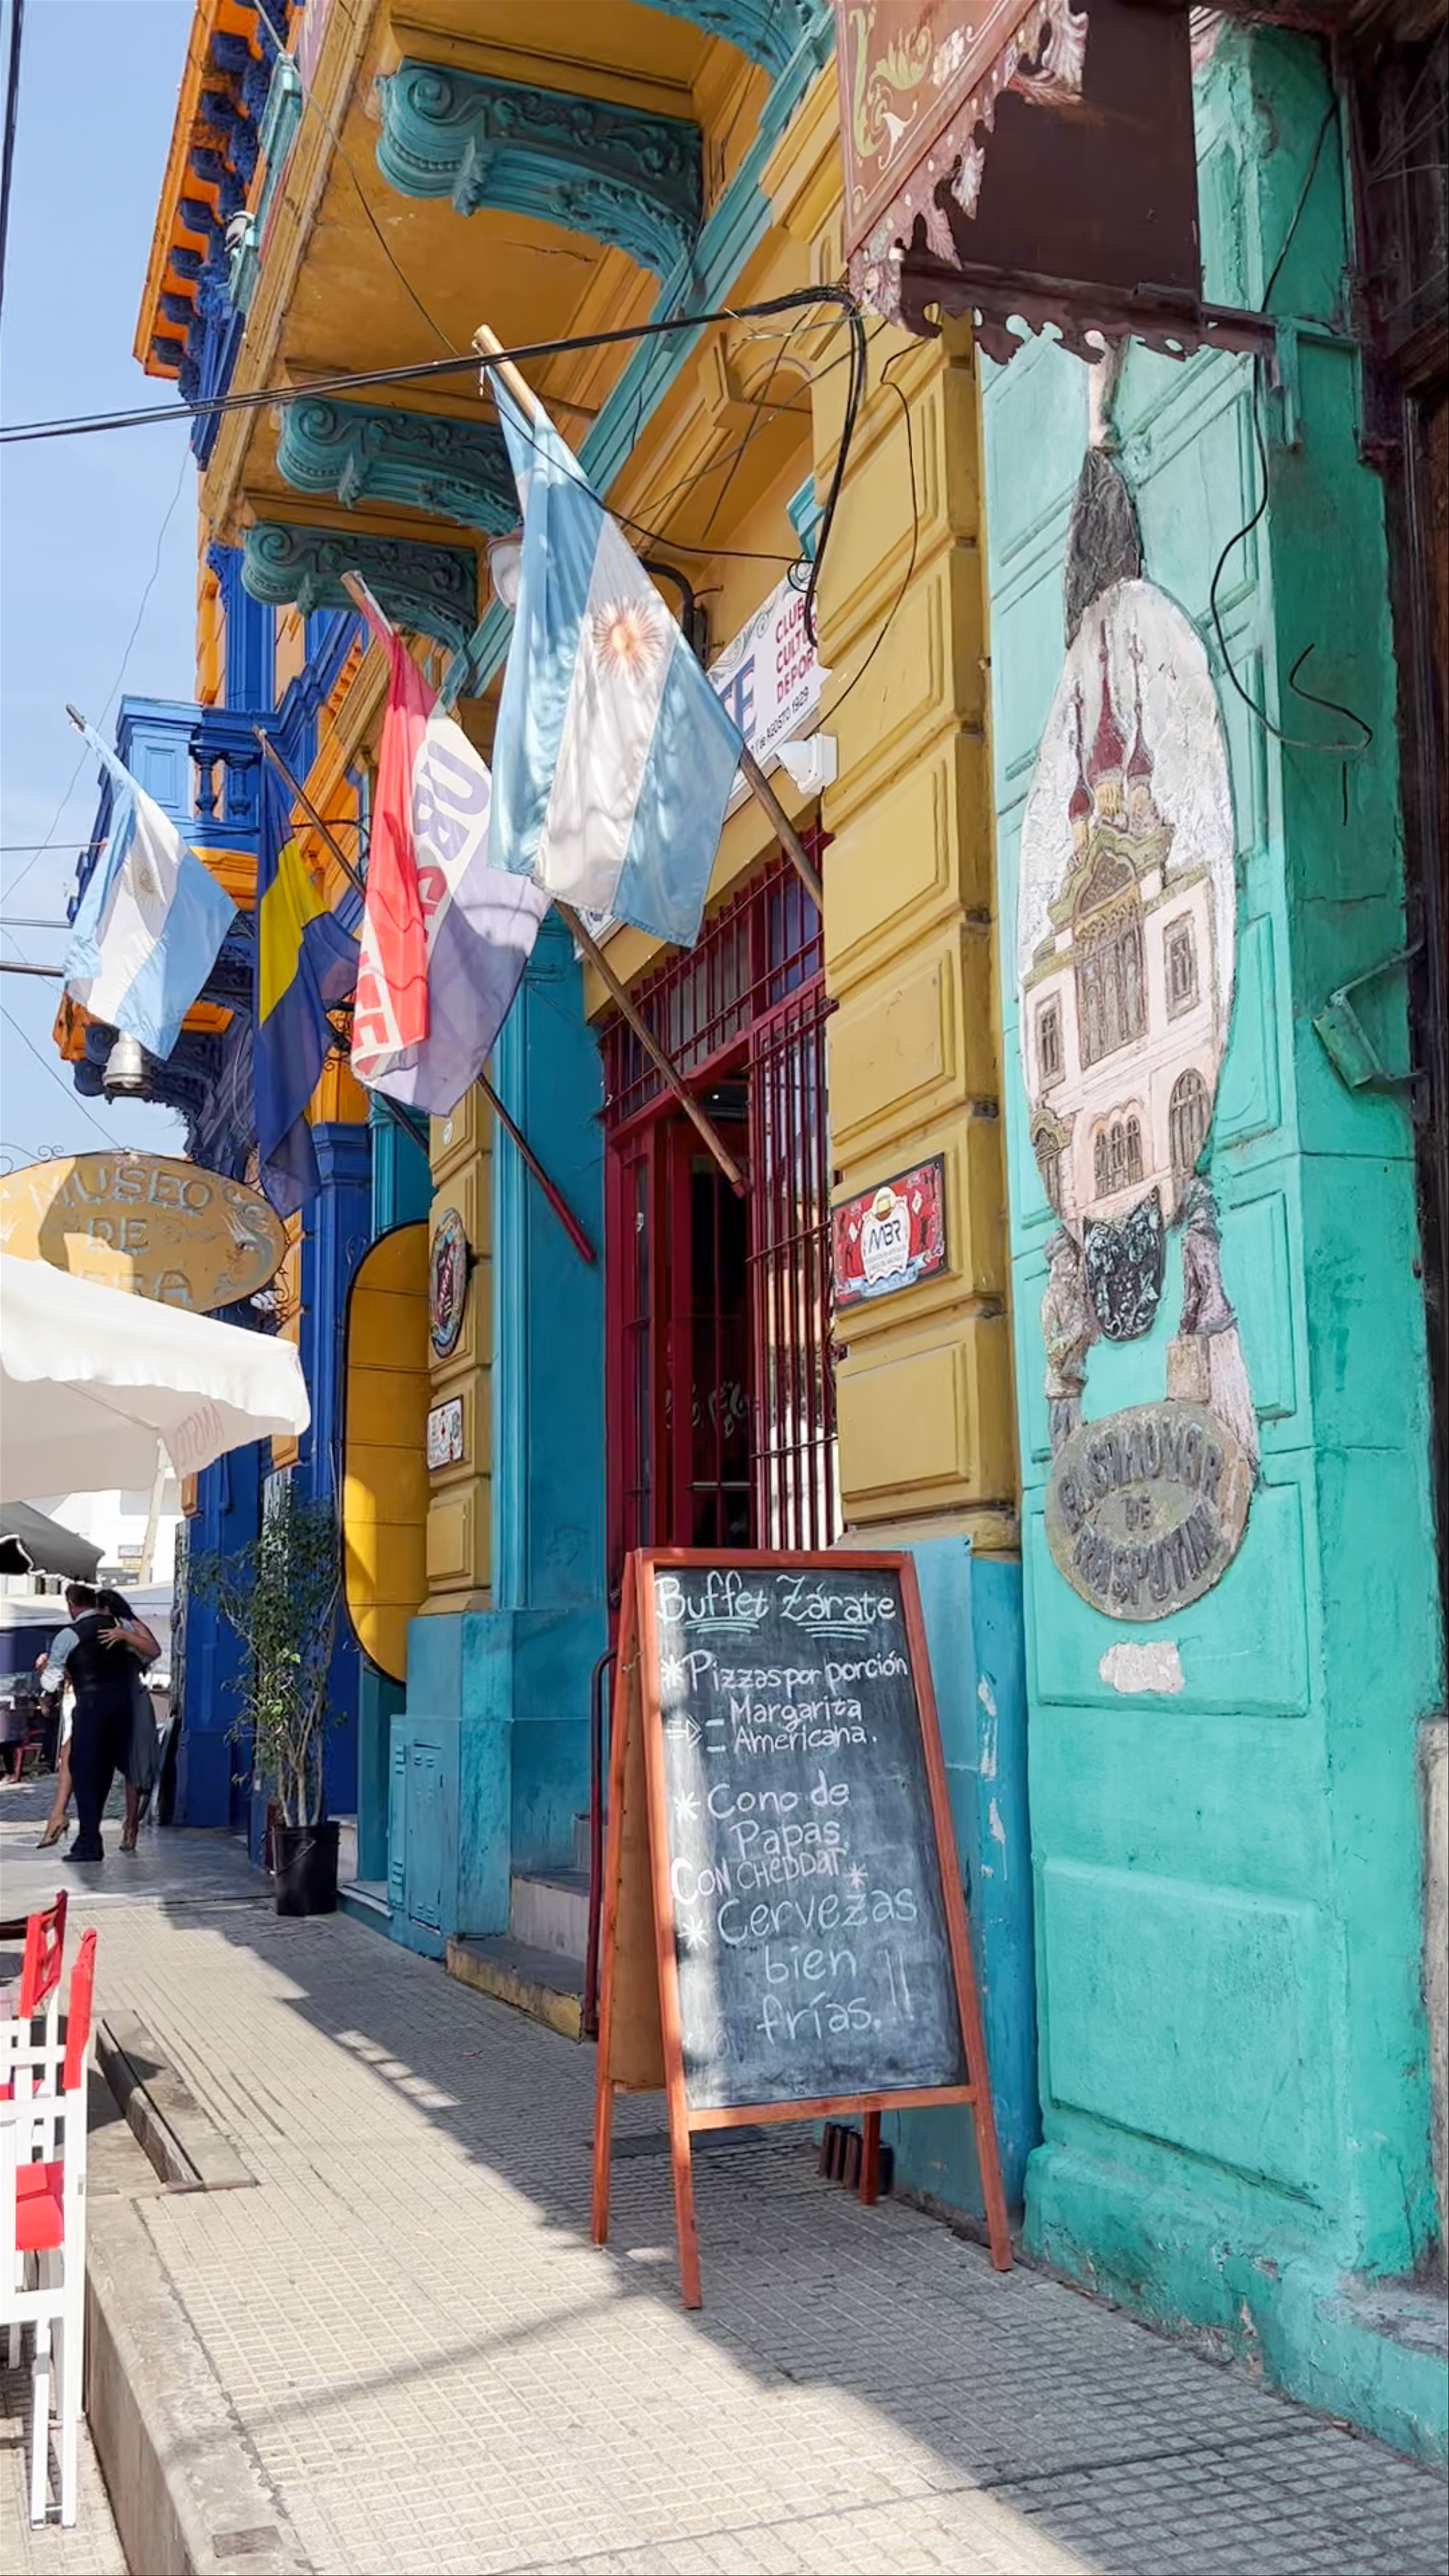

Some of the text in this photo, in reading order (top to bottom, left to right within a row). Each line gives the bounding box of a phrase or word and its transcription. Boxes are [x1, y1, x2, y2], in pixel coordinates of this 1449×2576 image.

[776, 597, 804, 644] CLUB
[767, 707, 791, 742] AGOSTO
[28, 1167, 212, 1217] MUSEO
[85, 1216, 149, 1255] DE
[654, 1570, 897, 1624] Buffet Zárate
[682, 1650, 782, 1691] Pizzas
[823, 1650, 908, 1695] porción
[730, 1694, 863, 1732] Margarita
[707, 1769, 850, 1819] Cono de
[718, 1889, 917, 1944] Cervezas
[765, 1945, 857, 1983] bien
